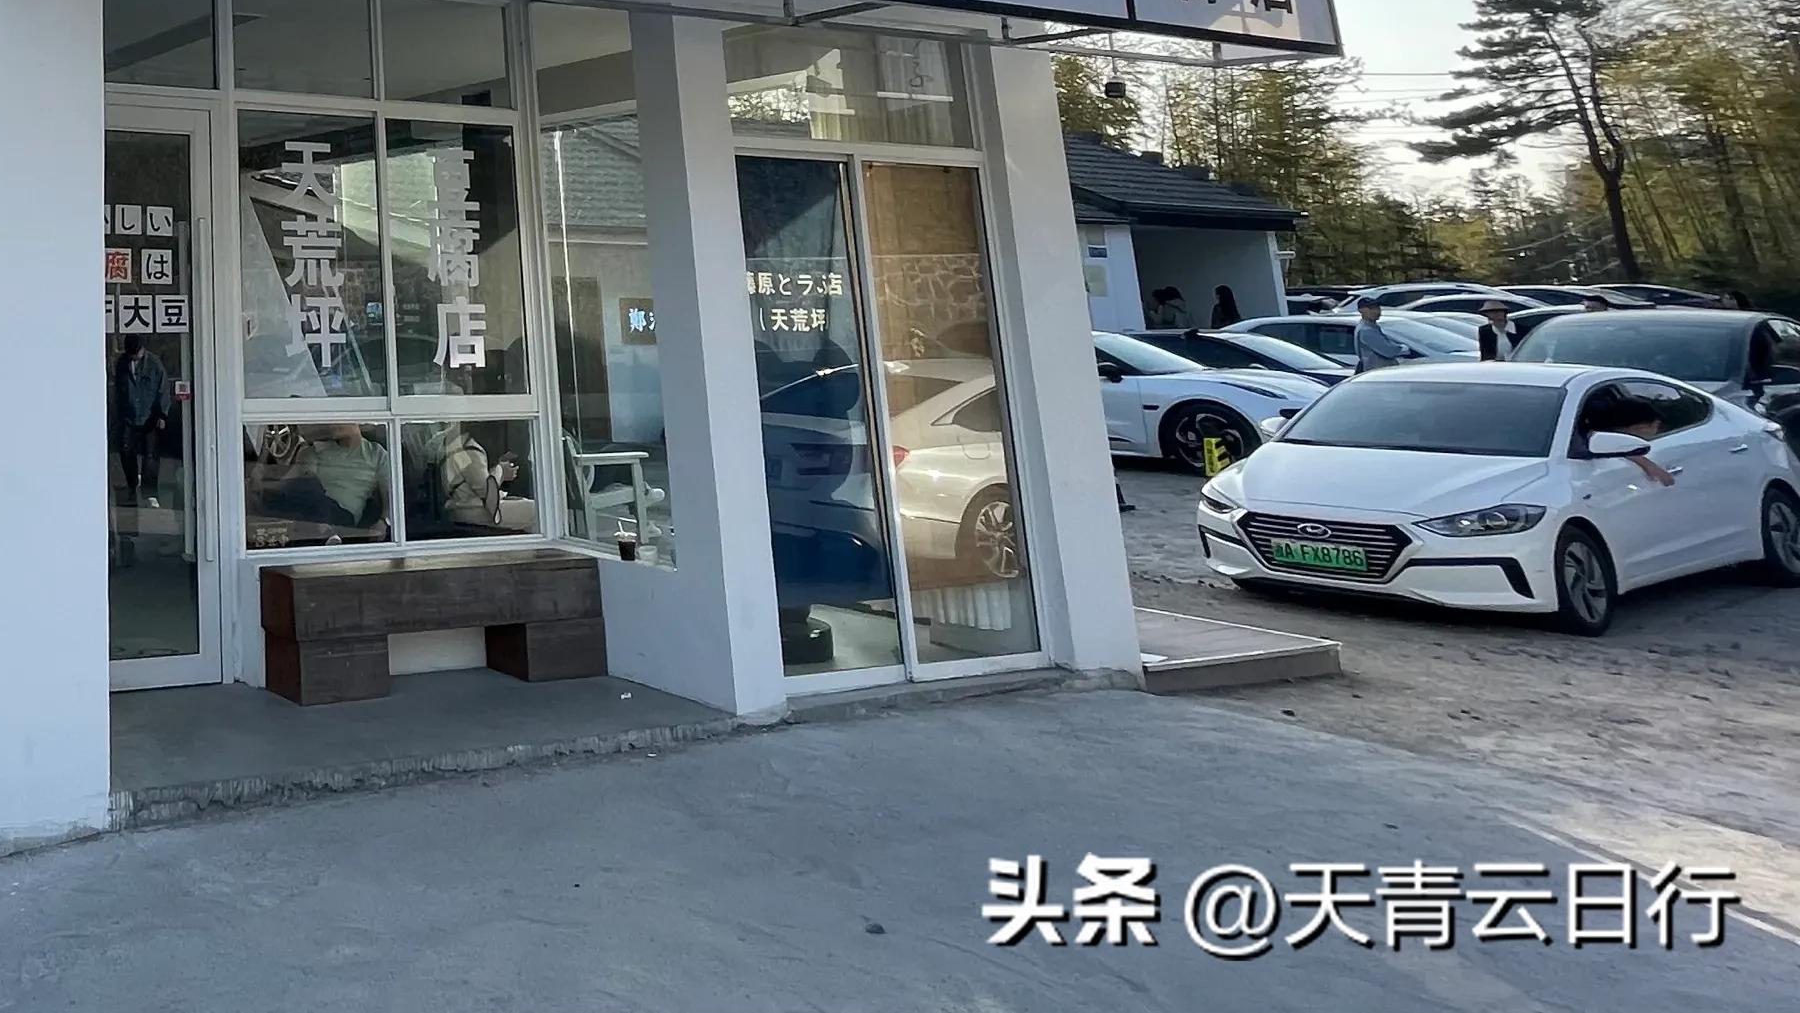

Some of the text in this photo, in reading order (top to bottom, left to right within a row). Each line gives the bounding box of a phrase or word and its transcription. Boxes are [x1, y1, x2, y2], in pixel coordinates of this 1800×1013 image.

[104, 207, 172, 233] しい
[280, 141, 347, 368] 天荒坪
